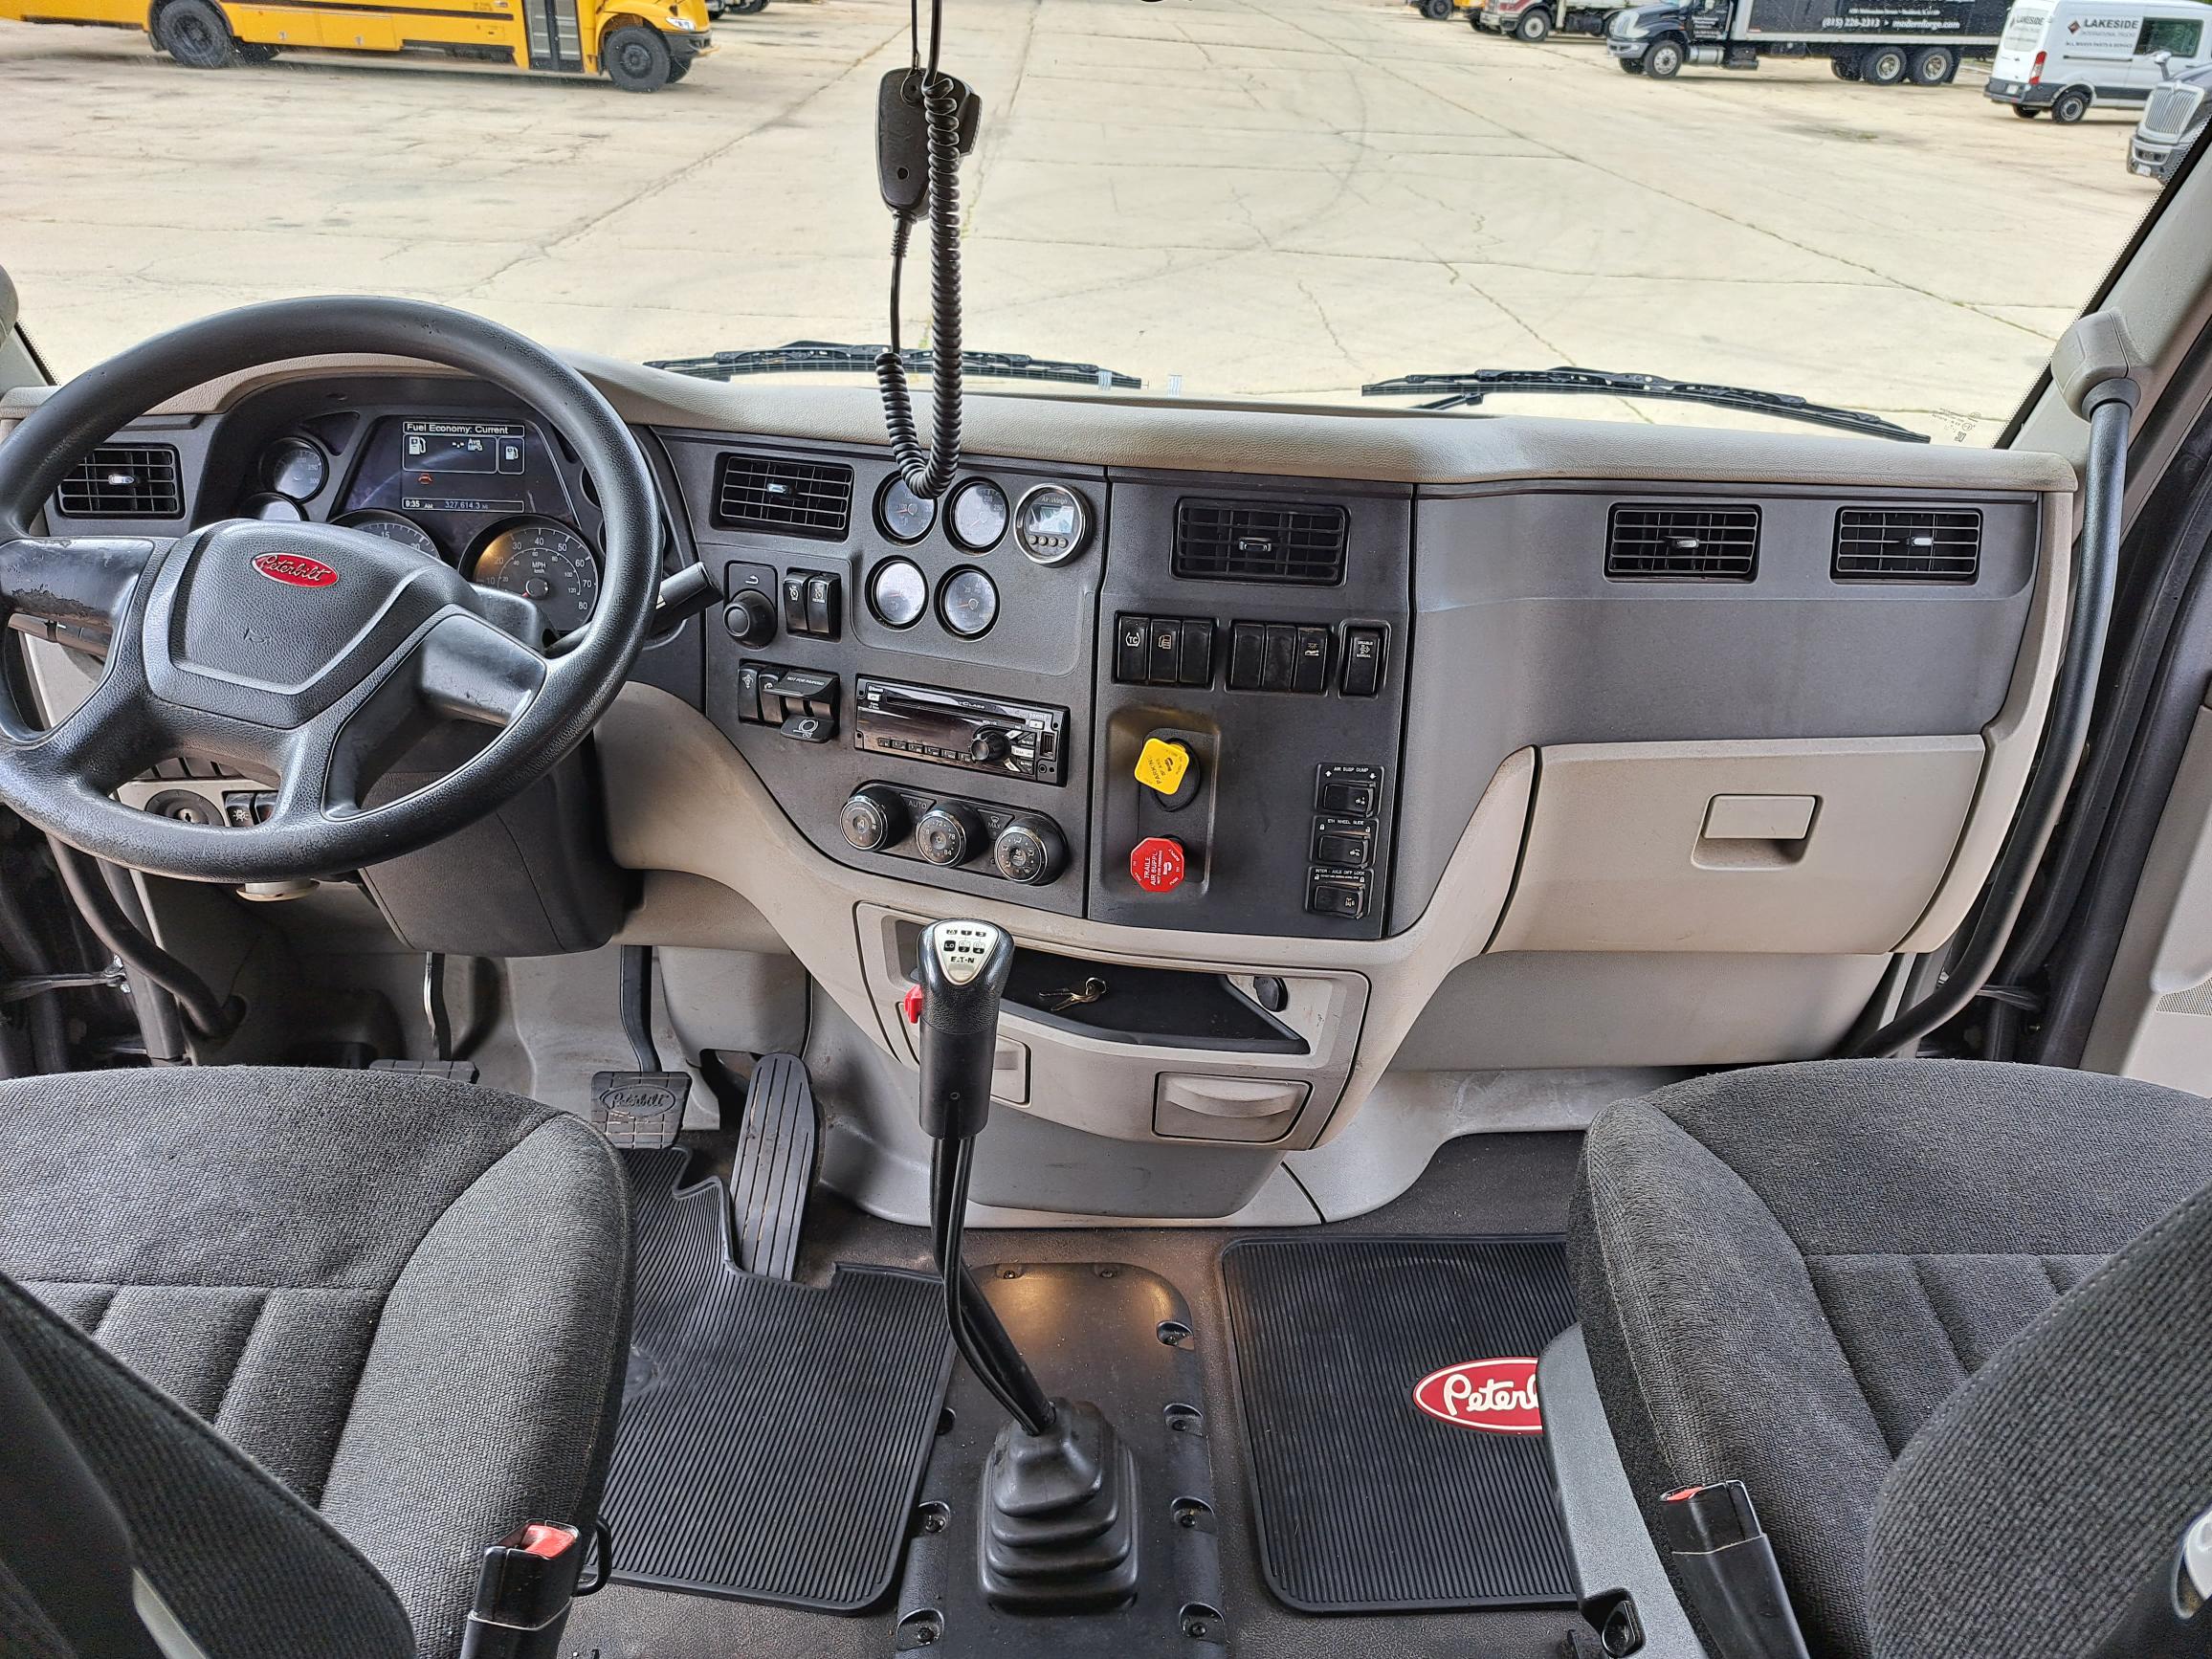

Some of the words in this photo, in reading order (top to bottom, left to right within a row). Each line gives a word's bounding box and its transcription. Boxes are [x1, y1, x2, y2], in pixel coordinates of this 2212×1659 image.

[2084, 18, 2139, 29] LAKESIDE
[407, 423, 427, 431] Fuel
[429, 424, 473, 434] Economy:
[475, 426, 509, 434] Current
[405, 499, 421, 508] 9:35
[512, 542, 522, 550] 30
[535, 537, 544, 546] 40
[557, 542, 567, 552] 50
[575, 559, 585, 567] 60
[255, 555, 331, 581] Peterbilt
[487, 576, 496, 585] 10
[583, 580, 592, 588] 70
[578, 602, 588, 610] 80
[1146, 756, 1162, 785] PARKIN
[908, 800, 927, 809] AUTO
[1443, 1373, 1539, 1417] Peter
